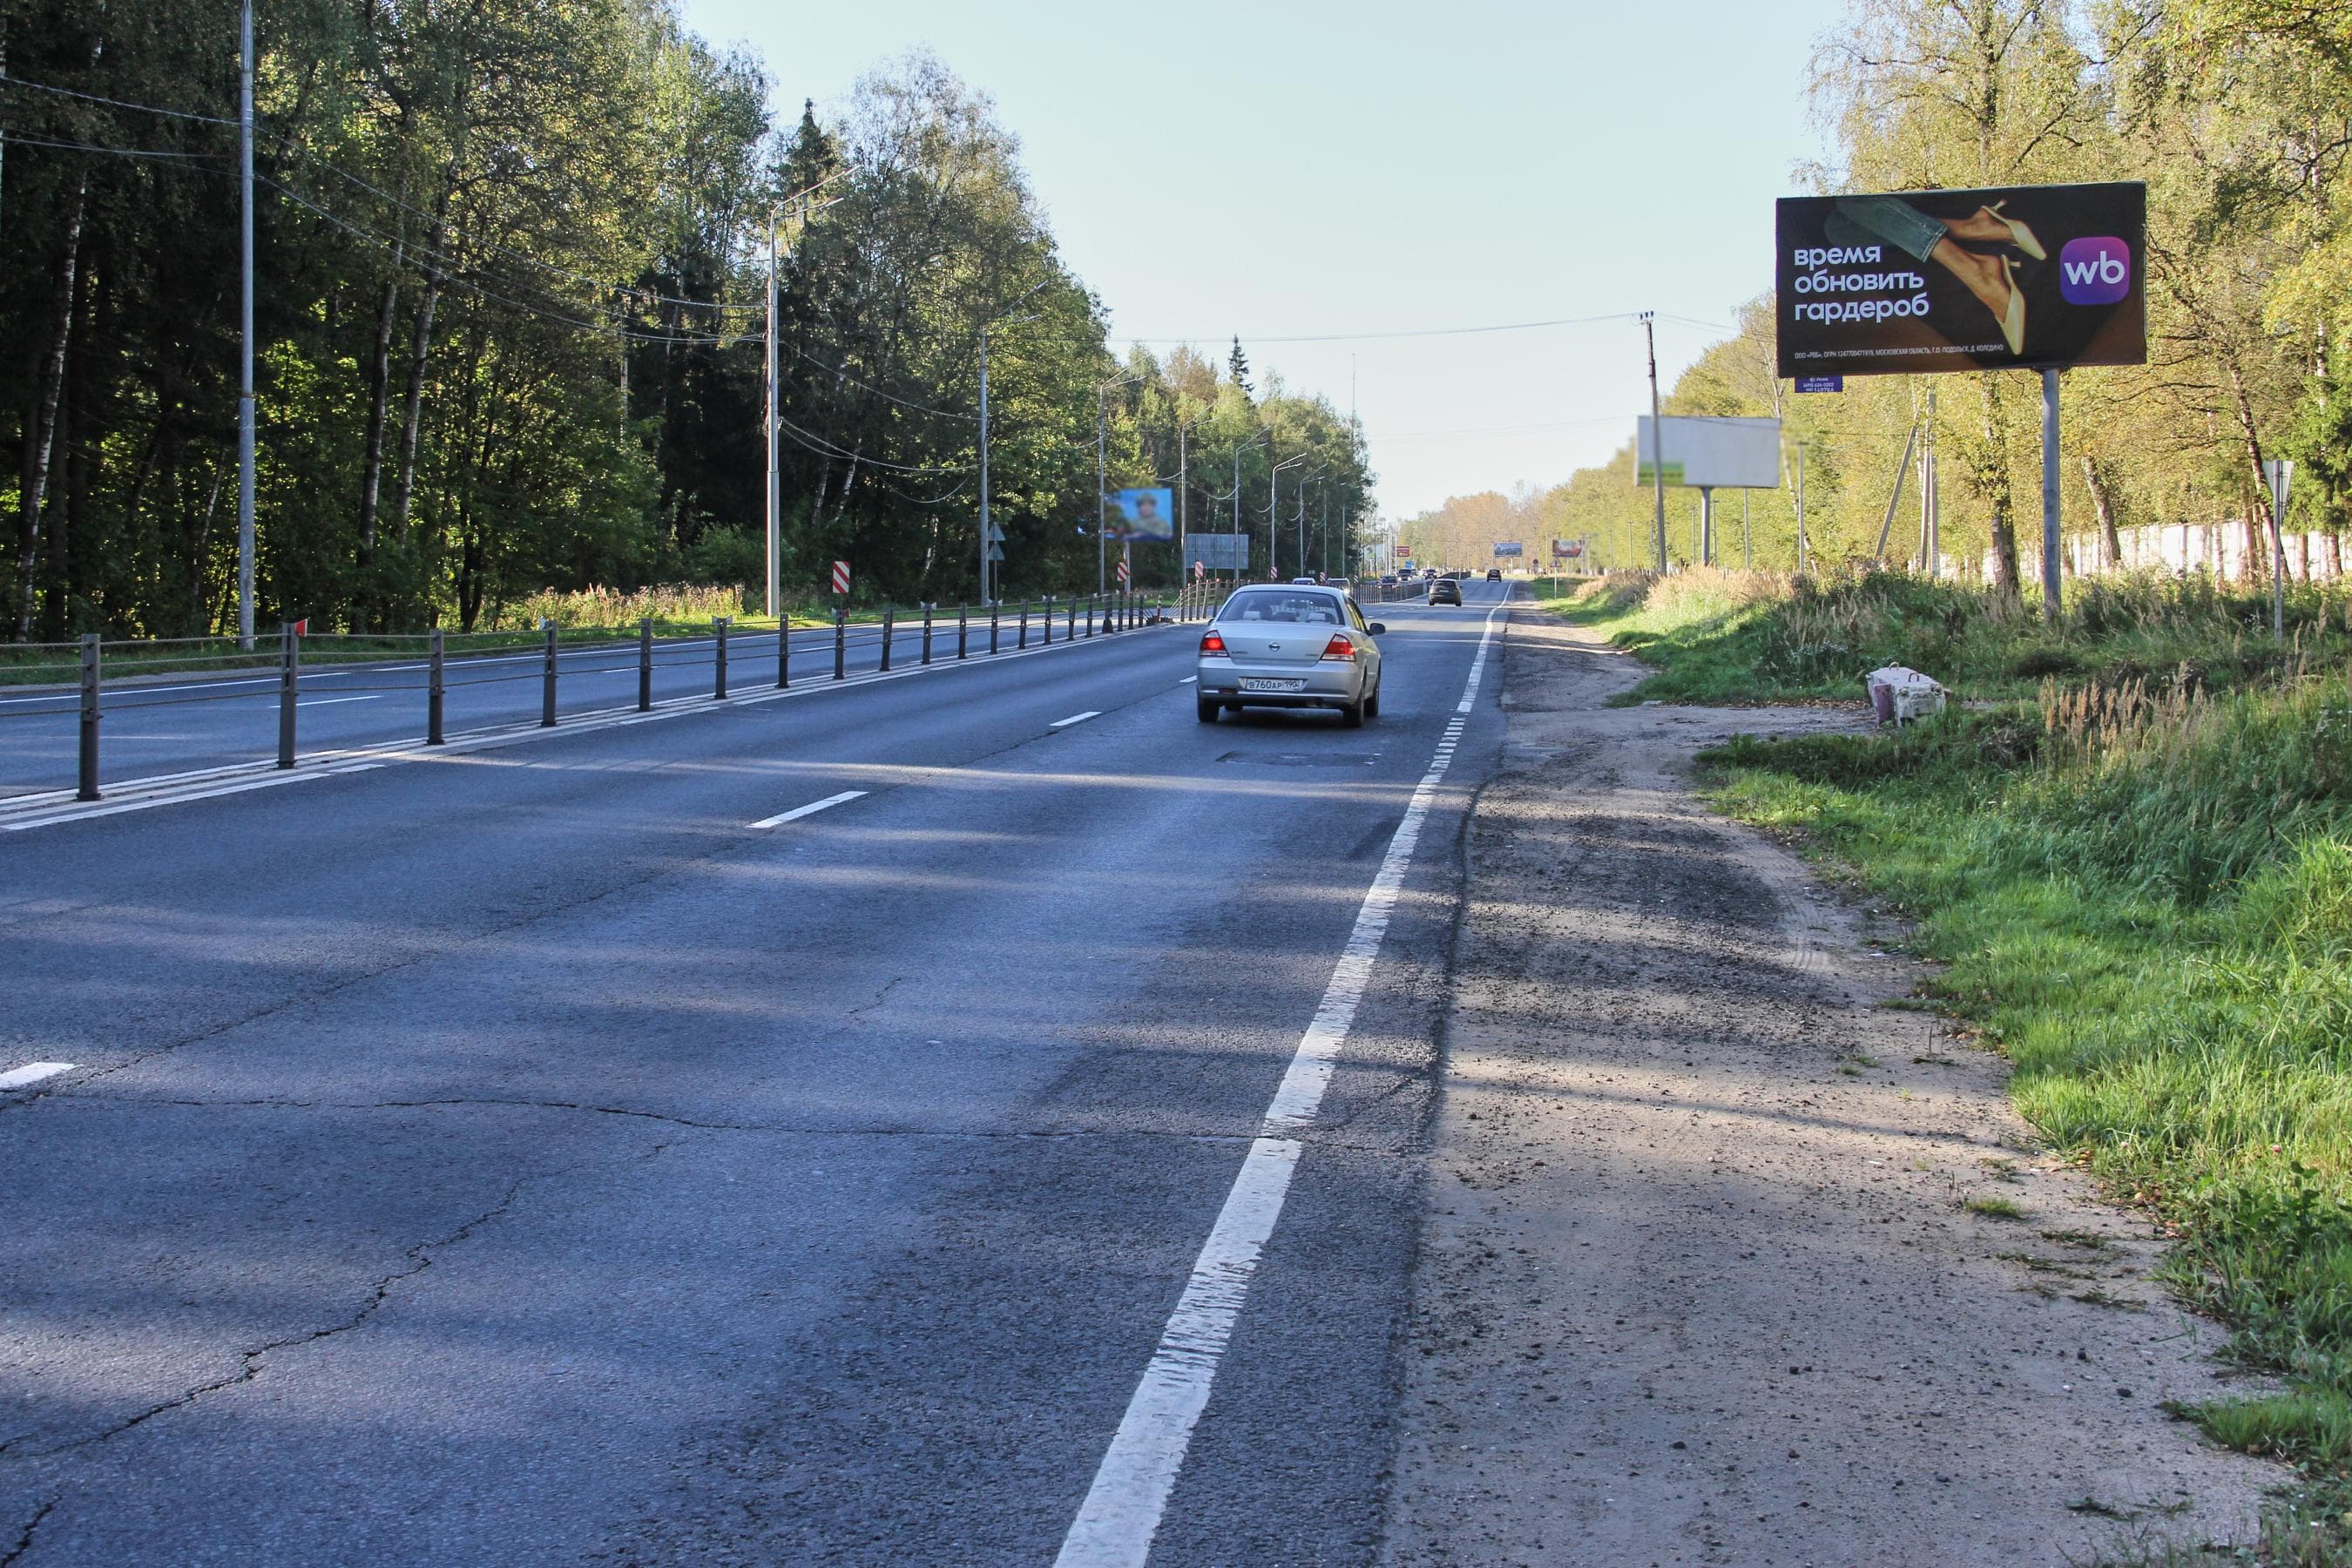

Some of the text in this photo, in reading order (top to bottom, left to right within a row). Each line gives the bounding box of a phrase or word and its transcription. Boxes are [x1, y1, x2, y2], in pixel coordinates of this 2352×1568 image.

[1794, 246, 1882, 271] время
[2064, 251, 2126, 285] wb
[1794, 268, 1924, 294] обновить
[1794, 292, 1930, 325] гардероб
[1876, 348, 1908, 356] МОСКОВСКАЯ
